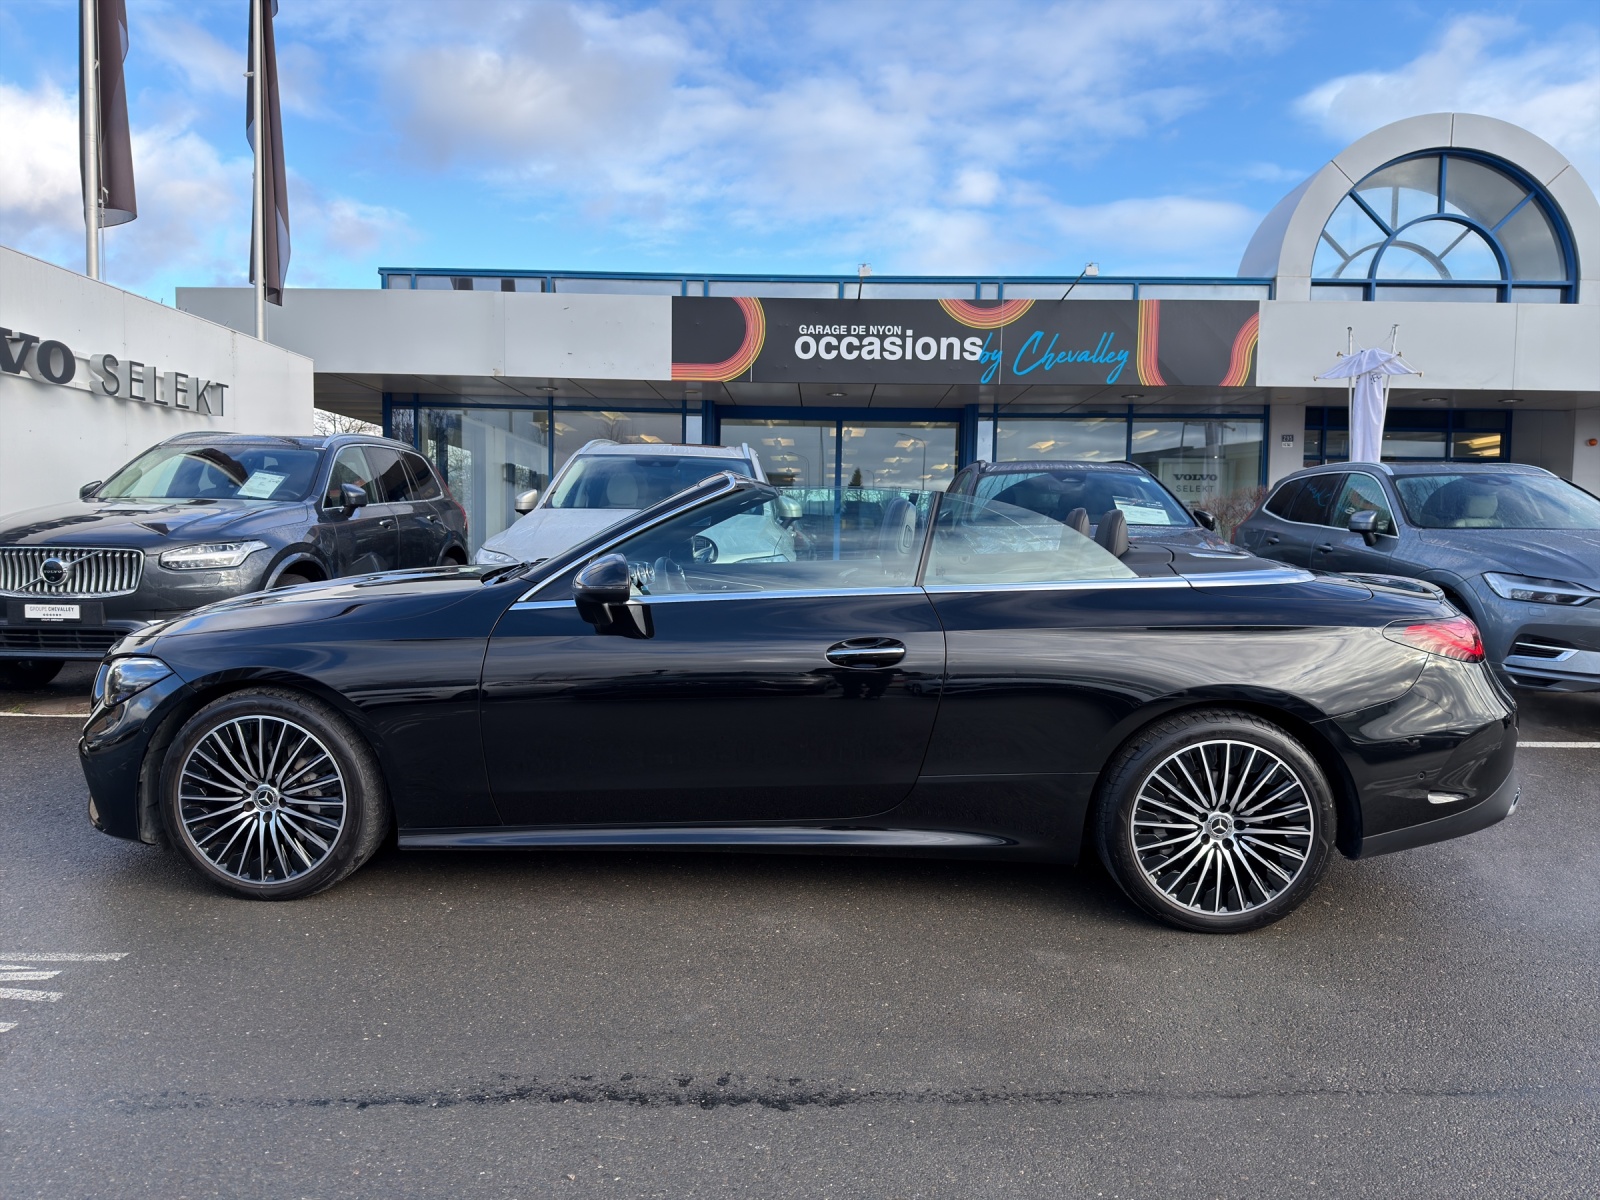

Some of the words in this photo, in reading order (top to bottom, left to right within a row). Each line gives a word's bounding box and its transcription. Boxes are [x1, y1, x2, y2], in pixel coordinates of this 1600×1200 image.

[799, 325, 848, 335] GARAGE
[850, 325, 866, 335] DE
[869, 325, 902, 335] NYON
[794, 330, 983, 361] occasions
[979, 332, 1003, 384] by
[1012, 330, 1130, 384] Chevalley
[101, 353, 229, 417] SELEKT
[1173, 473, 1218, 481] VOLVO
[1175, 484, 1214, 492] SELEKT
